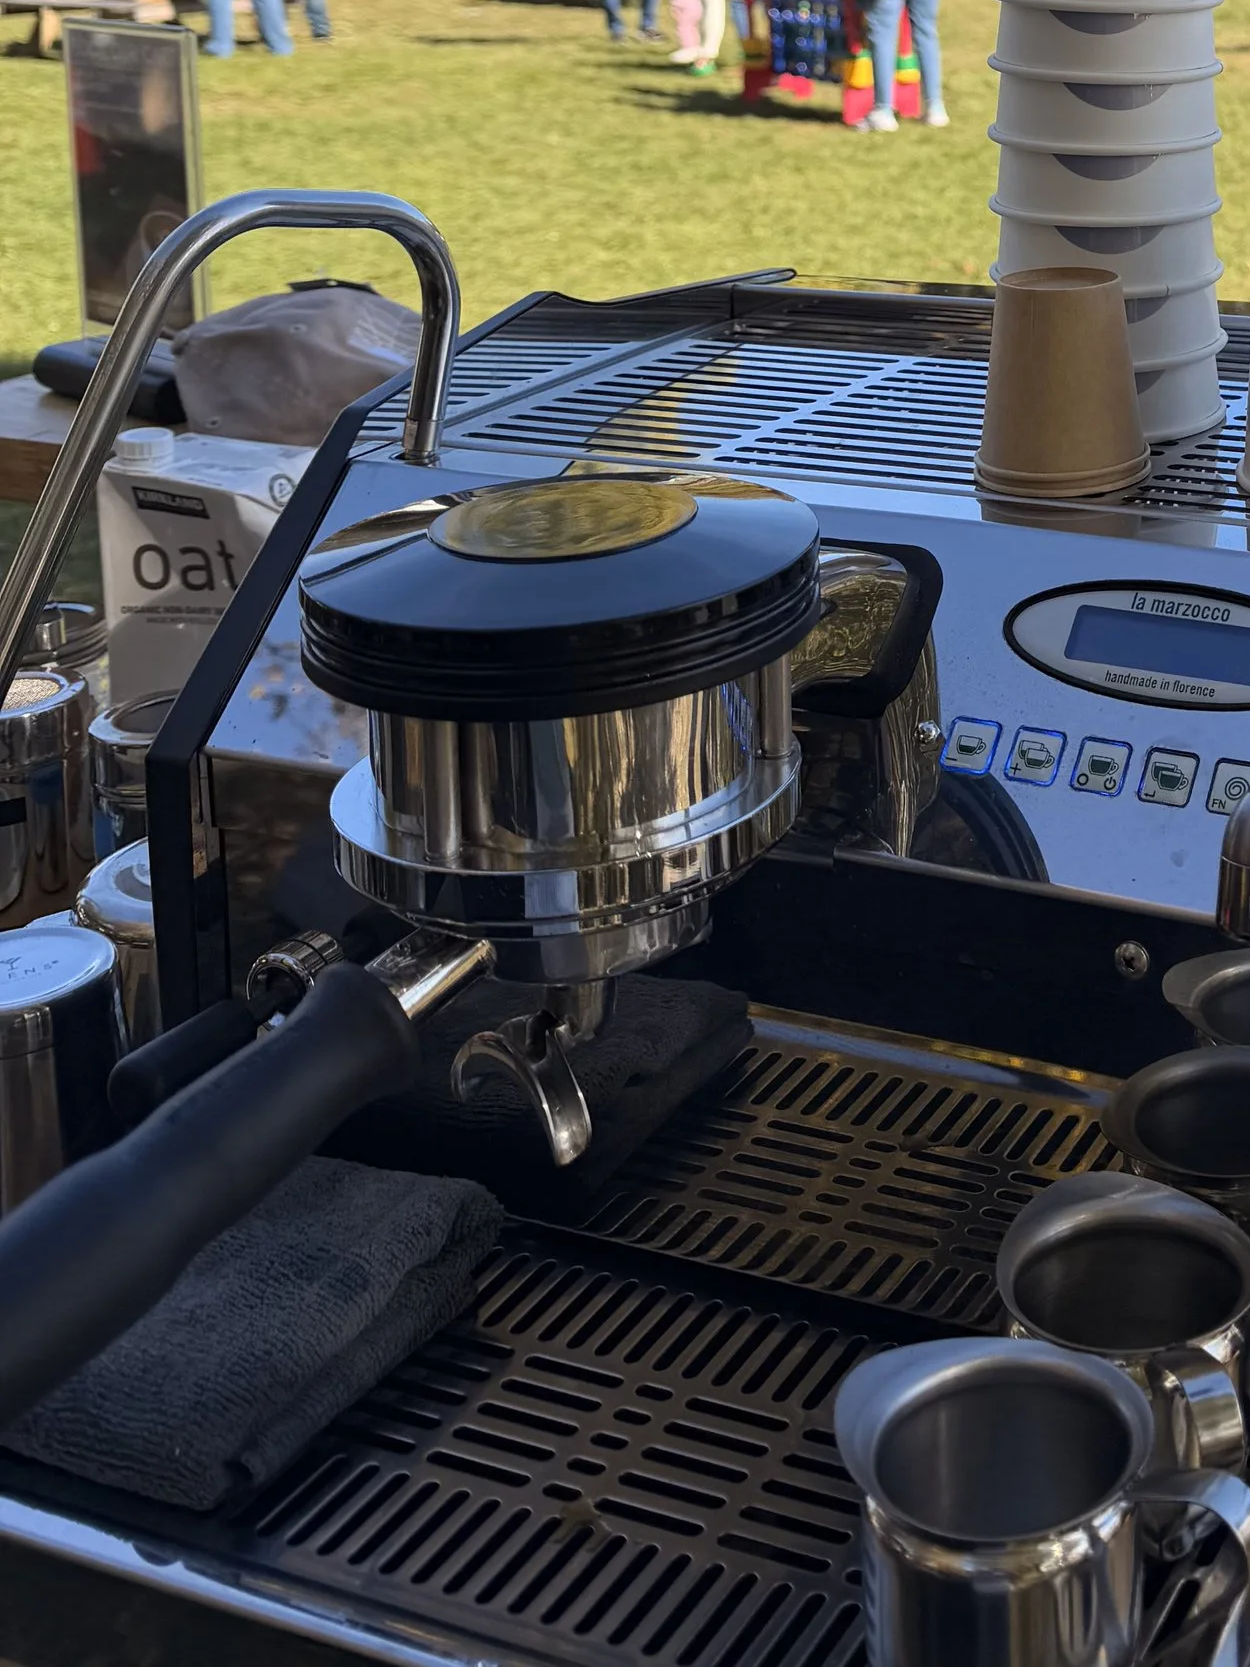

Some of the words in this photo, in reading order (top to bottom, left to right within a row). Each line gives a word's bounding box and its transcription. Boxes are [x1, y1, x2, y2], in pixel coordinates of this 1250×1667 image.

[137, 488, 205, 510] KIRKLAND
[132, 539, 238, 592] oat
[1131, 591, 1147, 611] la
[1150, 597, 1231, 623] marzocco
[1104, 669, 1158, 690] handmade
[1160, 678, 1170, 691] in
[1172, 679, 1216, 698] florence
[1211, 798, 1227, 809] FN
